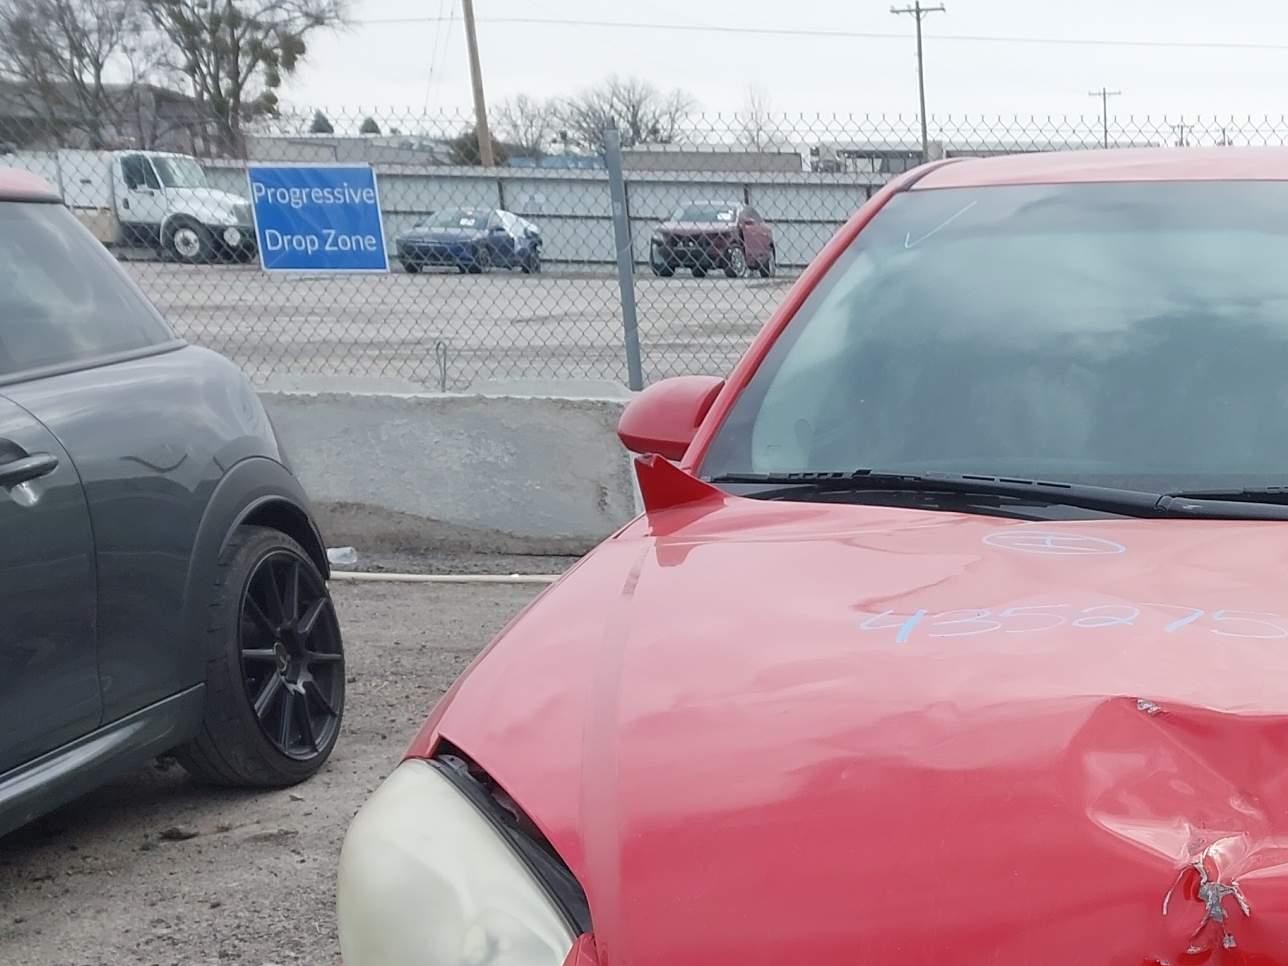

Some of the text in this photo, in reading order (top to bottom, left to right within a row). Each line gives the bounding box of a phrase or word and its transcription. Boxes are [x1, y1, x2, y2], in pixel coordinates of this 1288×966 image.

[252, 182, 375, 209] Progressive
[265, 229, 377, 255] Drop Zone
